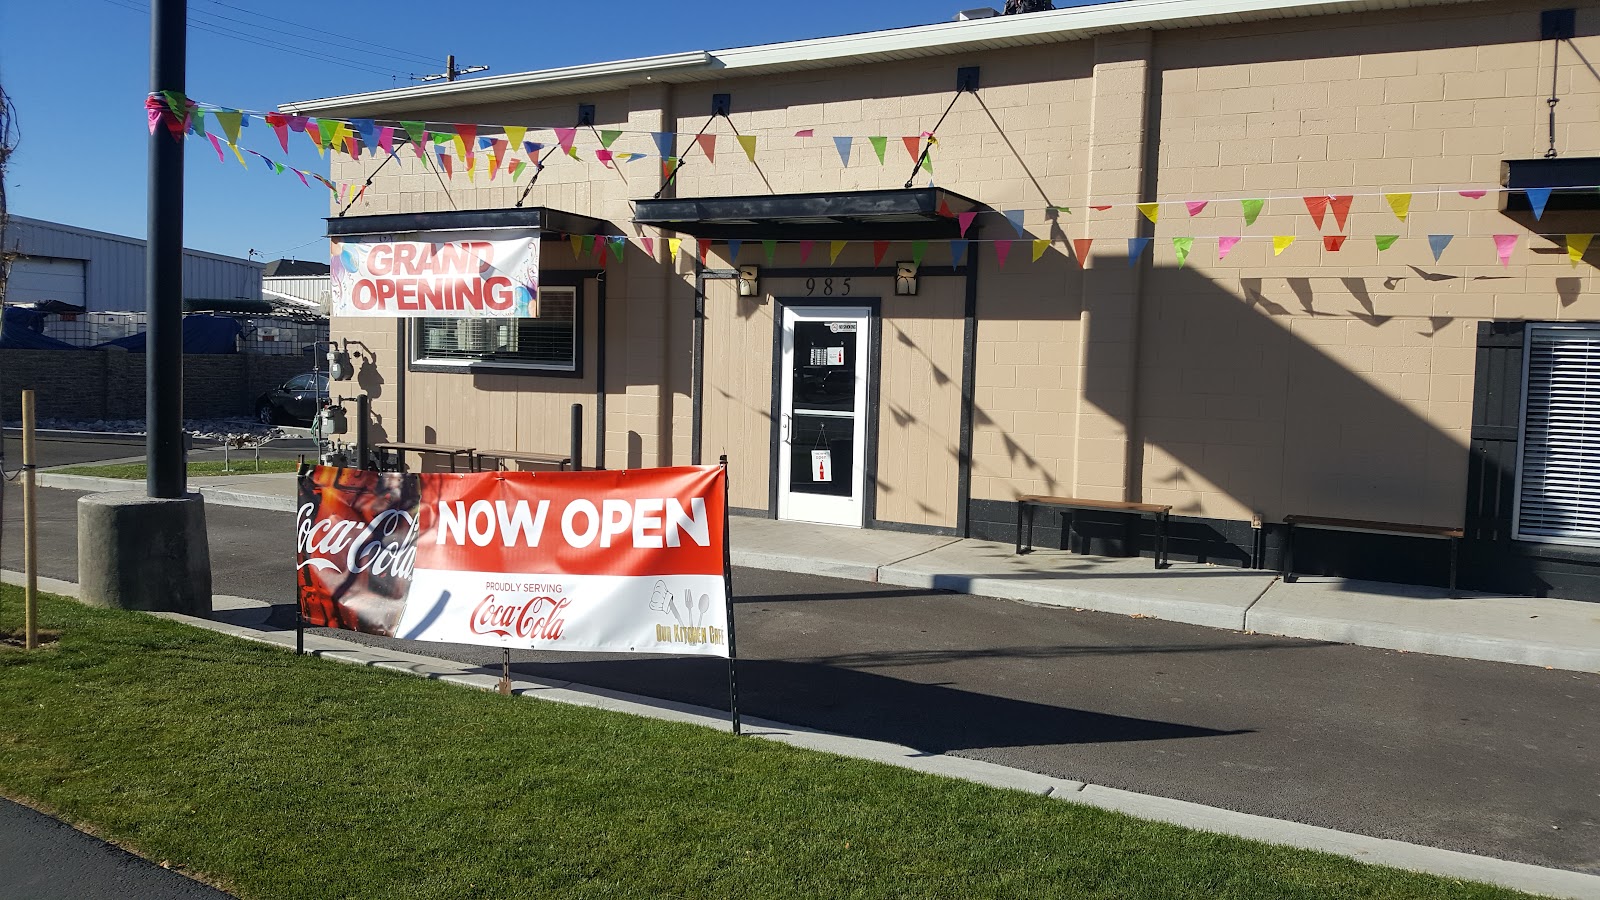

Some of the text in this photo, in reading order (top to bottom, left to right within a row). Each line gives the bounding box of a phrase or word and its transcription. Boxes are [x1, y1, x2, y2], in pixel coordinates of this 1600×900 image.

[366, 241, 495, 277] GRAND
[351, 276, 514, 311] OPENING
[806, 278, 851, 296] 985
[436, 497, 711, 549] NOW OPEN
[486, 581, 563, 594] PROUDLY SERVING
[469, 594, 572, 641] Coca-Cola
[655, 623, 672, 643] OUR
